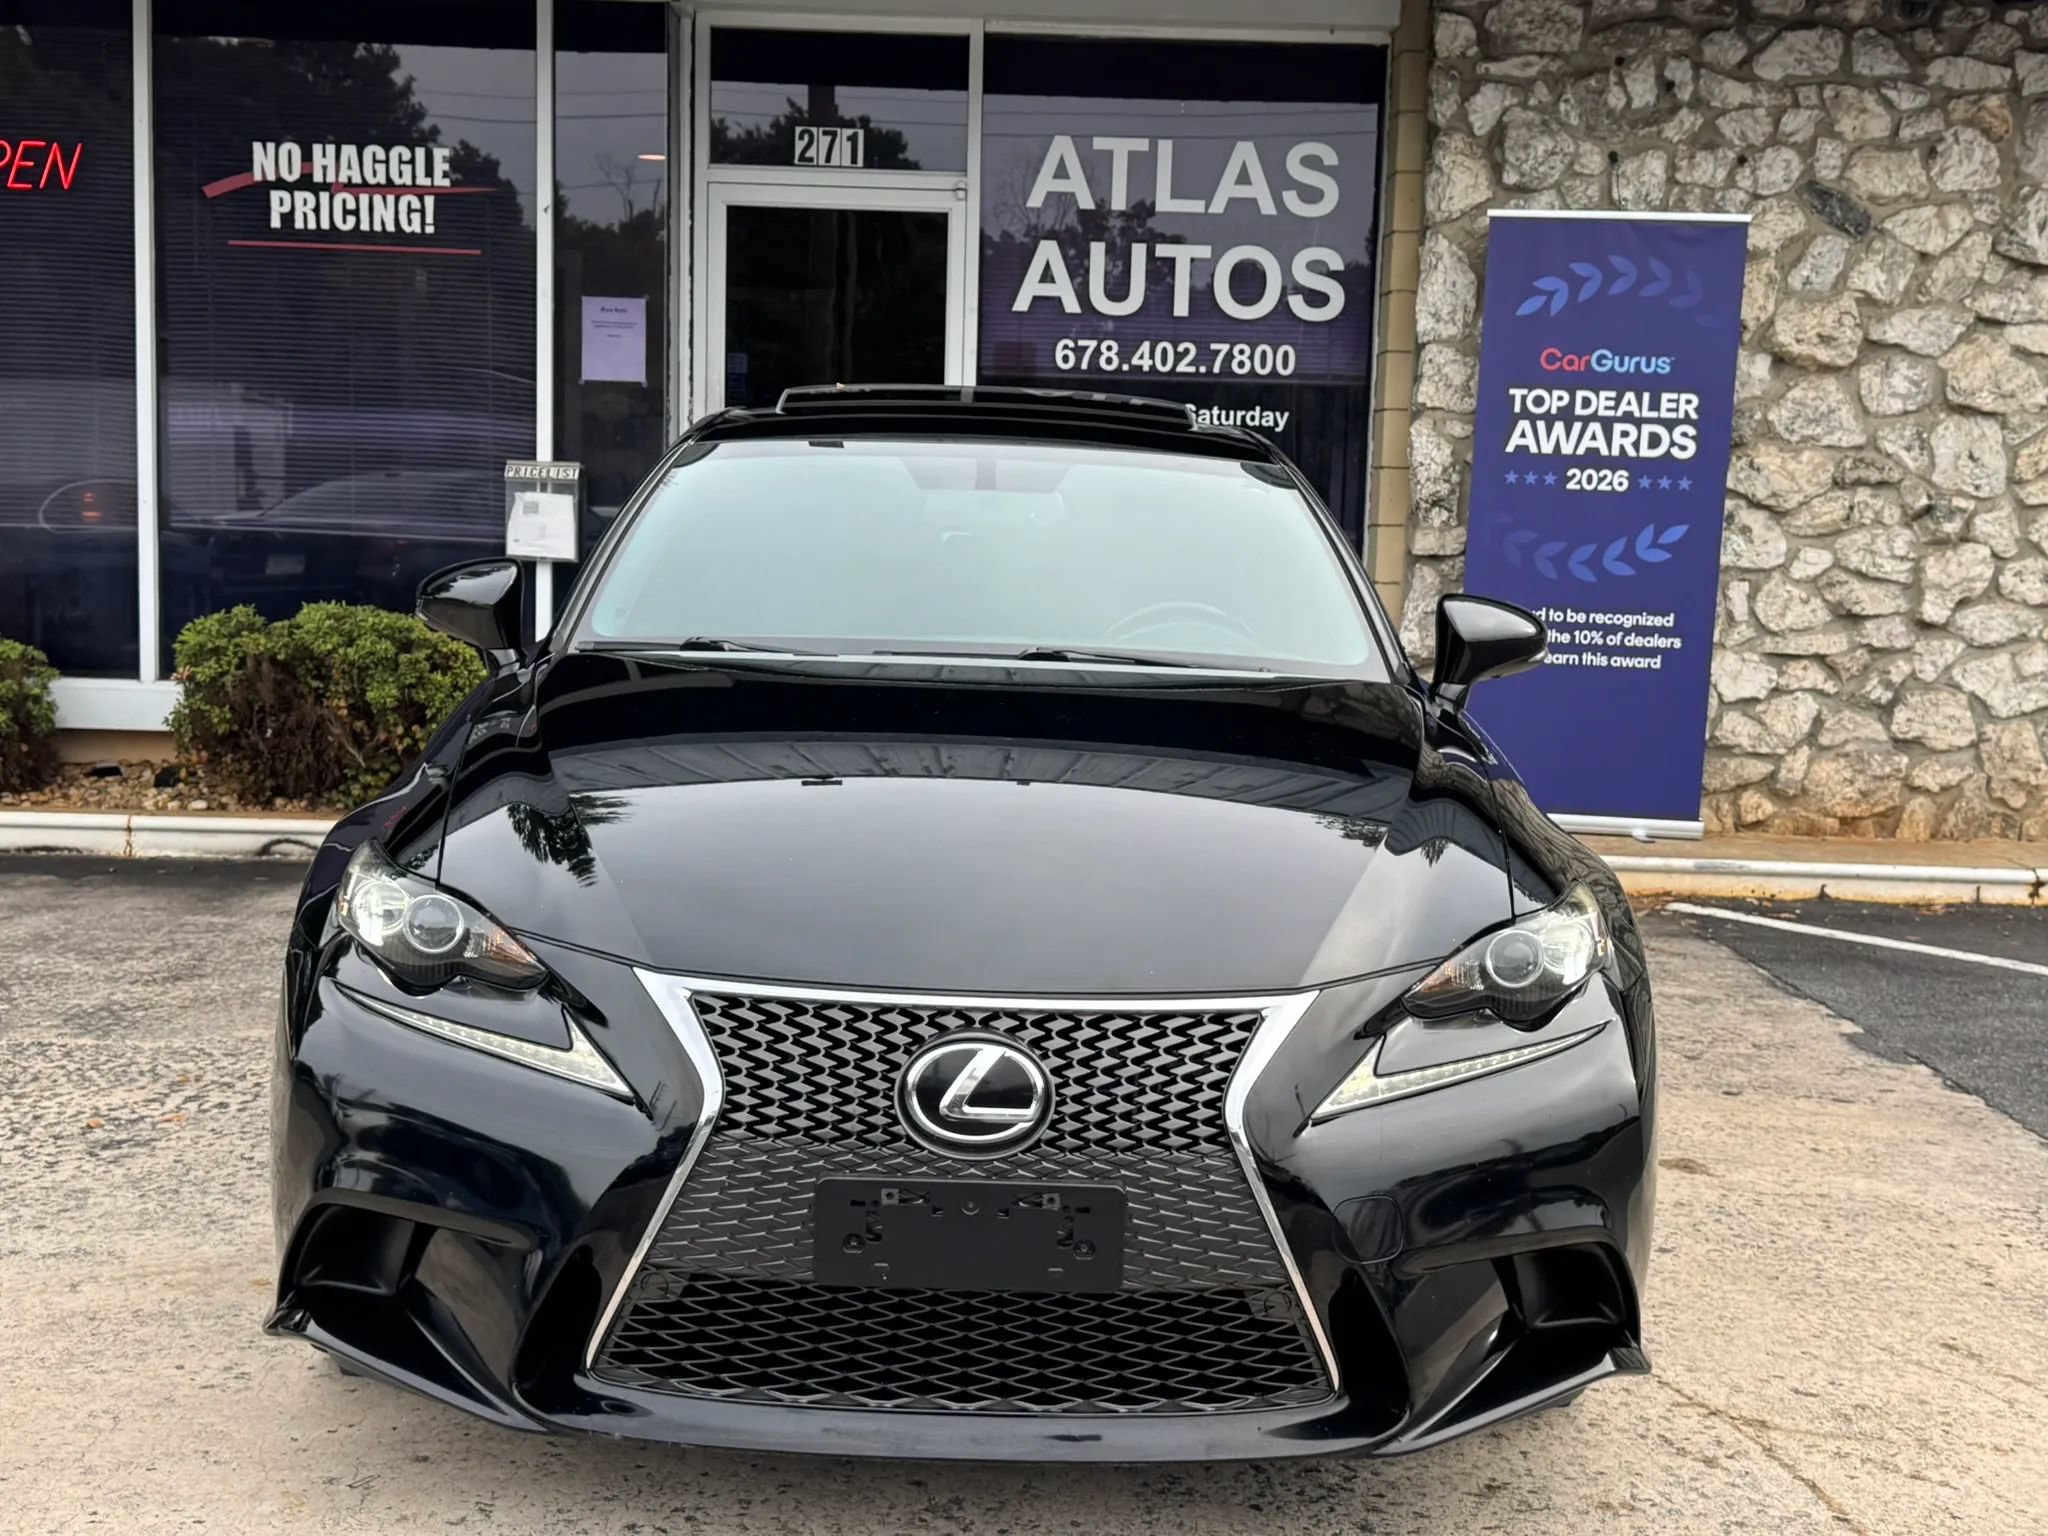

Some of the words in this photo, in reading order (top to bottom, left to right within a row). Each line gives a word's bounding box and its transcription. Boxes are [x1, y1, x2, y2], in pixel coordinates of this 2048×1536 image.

[252, 141, 301, 182] NO
[312, 143, 451, 187] HAGGLE
[797, 127, 859, 166] 271
[1025, 135, 1340, 218] ATLAS
[269, 190, 435, 234] PRICING!
[1011, 239, 1346, 322] AUTOS
[1054, 338, 1297, 376] 678.402.7800
[1540, 347, 1672, 374] CarGurus
[1508, 388, 1571, 415] TOP
[1574, 389, 1700, 420] DEALER
[1504, 419, 1698, 460] AWARDS
[1565, 468, 1630, 492] 2026
[1548, 608, 1564, 622] to
[1566, 608, 1587, 624] be
[1589, 612, 1675, 628] recognized
[1573, 630, 1603, 645] 10%
[1606, 631, 1624, 646] of
[1624, 632, 1682, 649] dealers
[1582, 651, 1608, 667] this
[1610, 655, 1662, 669] award
